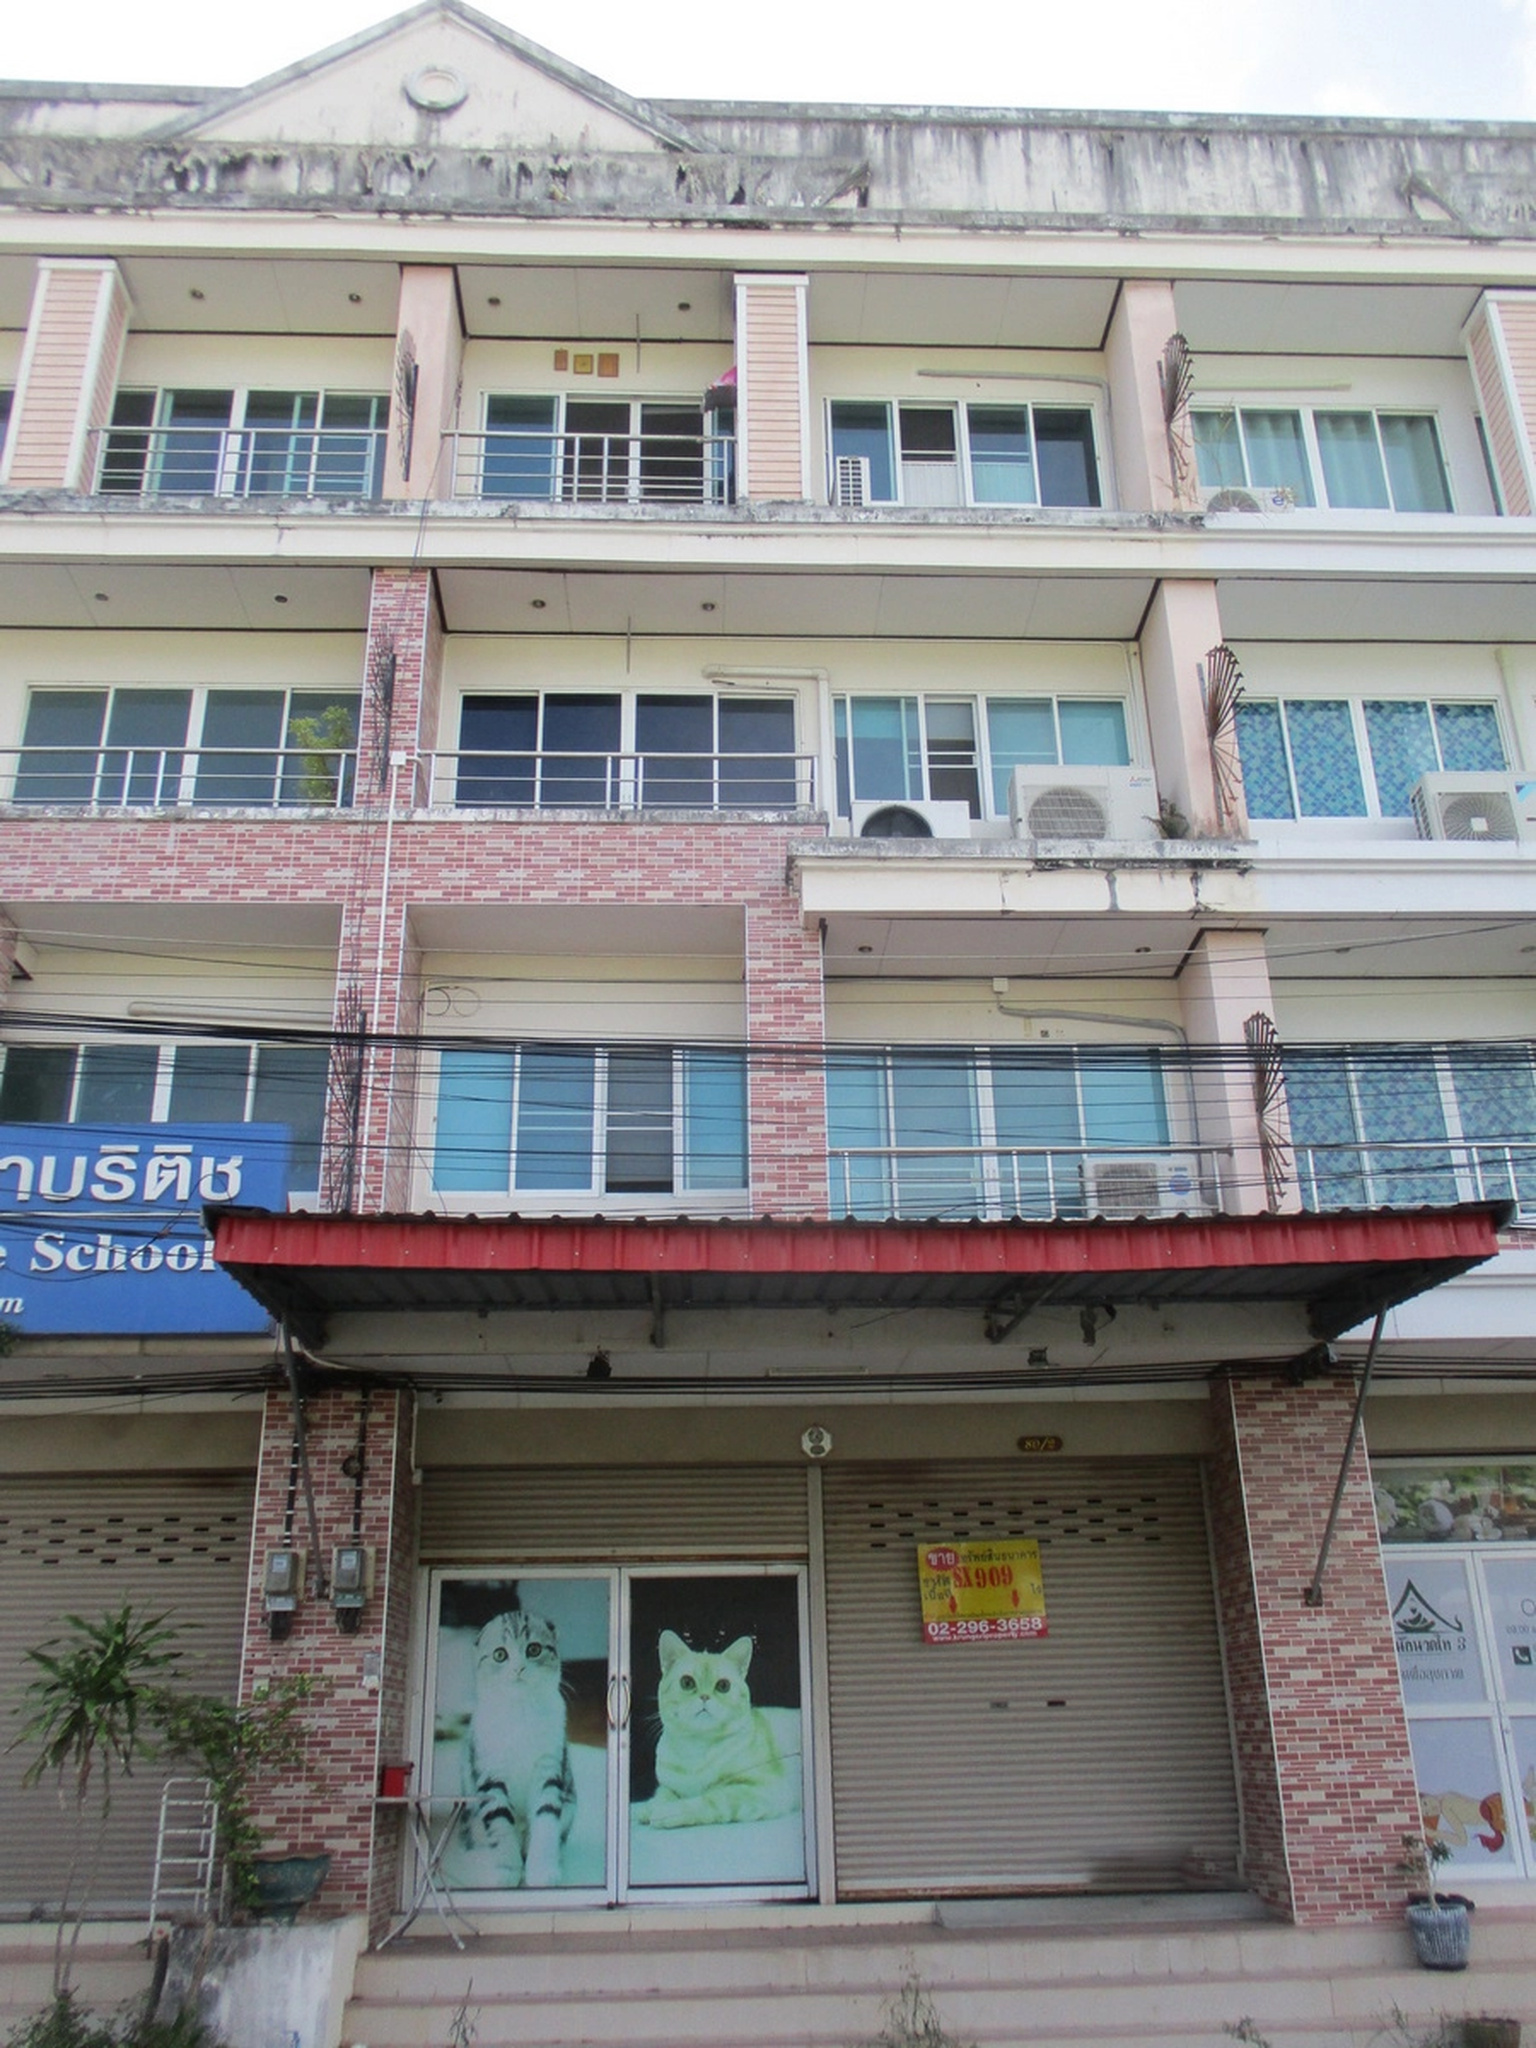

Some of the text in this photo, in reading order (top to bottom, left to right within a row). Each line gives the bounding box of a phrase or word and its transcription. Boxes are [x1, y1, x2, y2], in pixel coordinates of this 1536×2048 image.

[29, 1231, 216, 1273] School
[927, 1552, 956, 1566] ขาย
[927, 1616, 1042, 1636] 02-296-3658
[1457, 1636, 1466, 1651] 3
